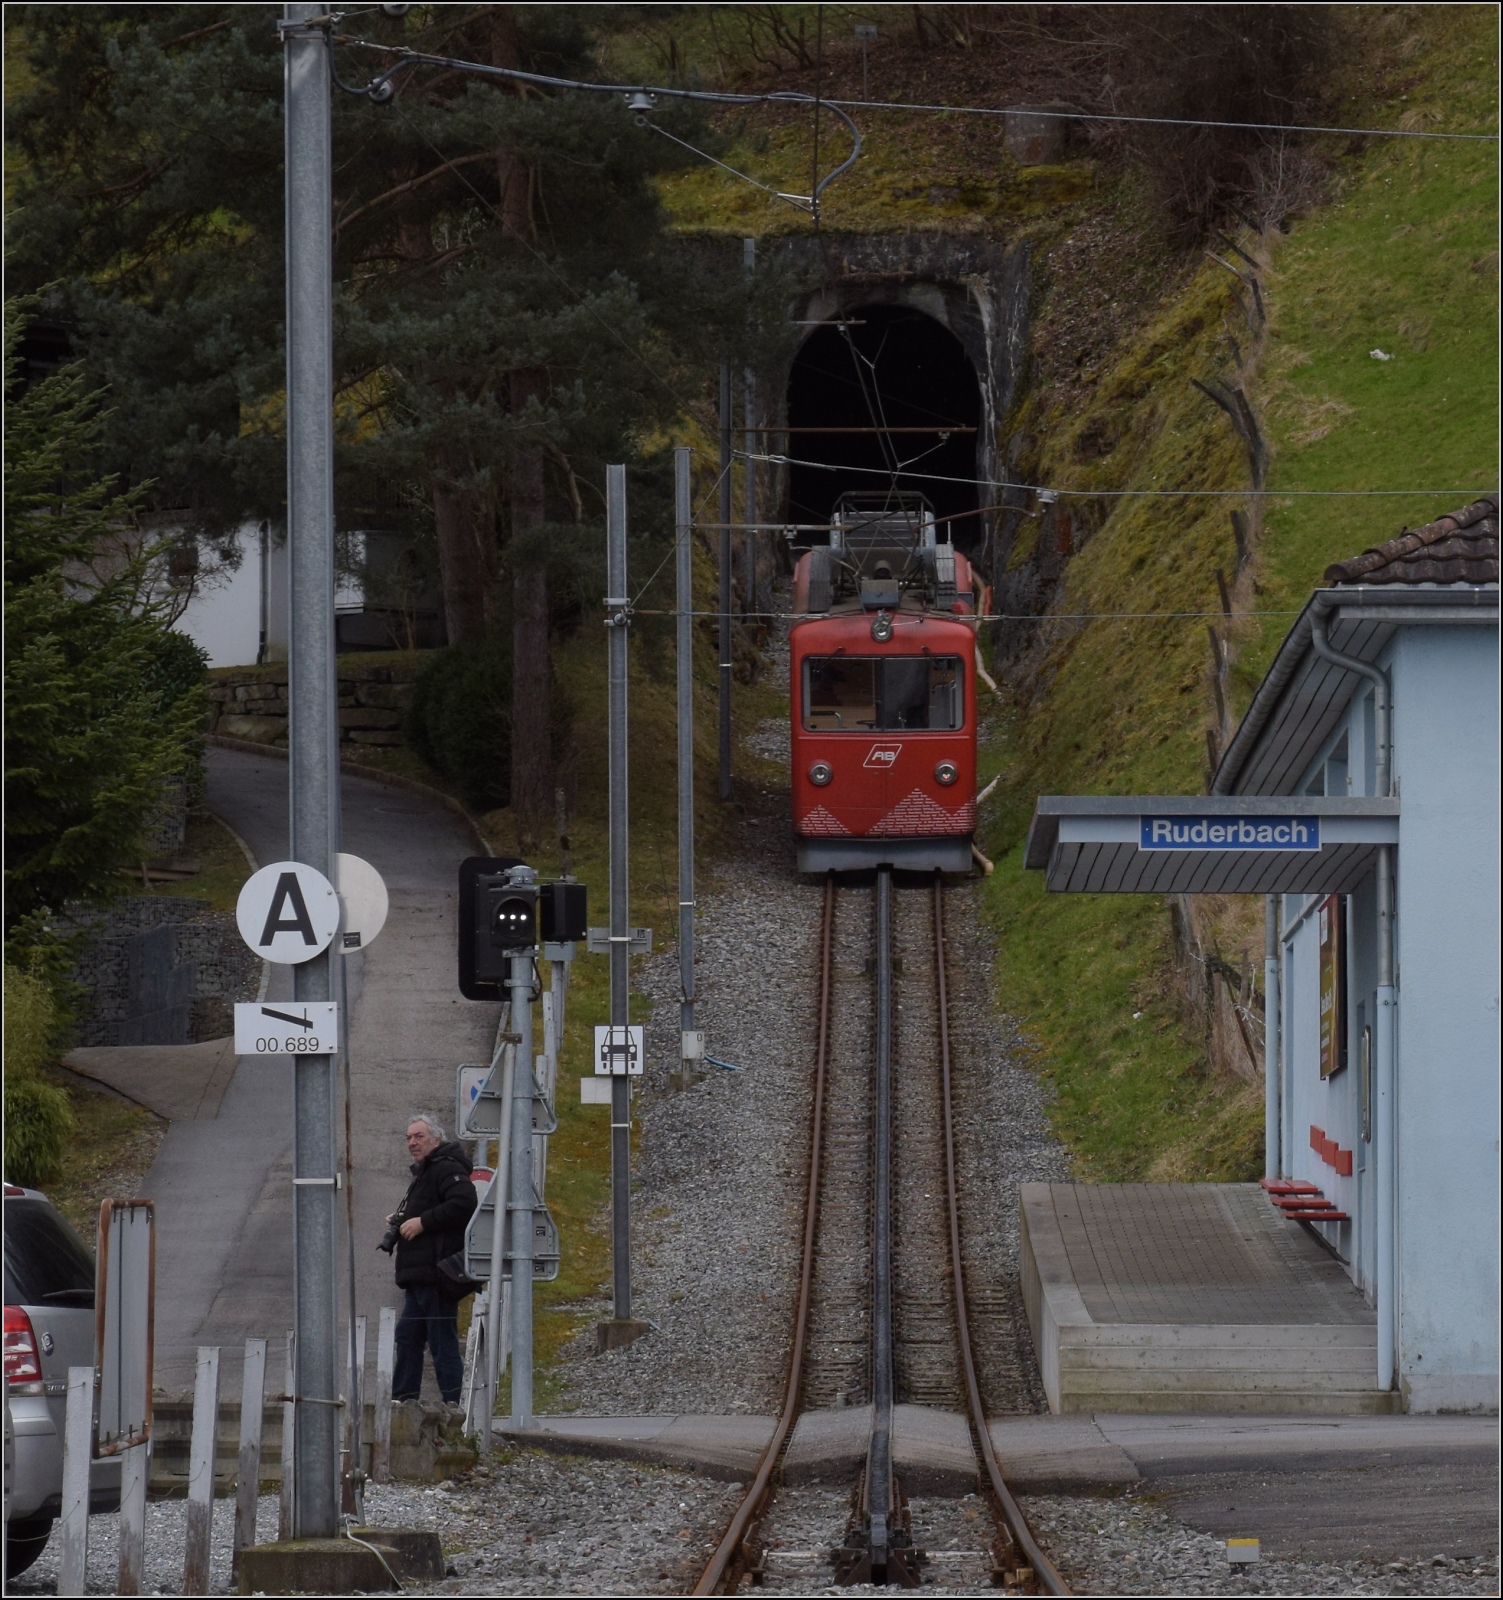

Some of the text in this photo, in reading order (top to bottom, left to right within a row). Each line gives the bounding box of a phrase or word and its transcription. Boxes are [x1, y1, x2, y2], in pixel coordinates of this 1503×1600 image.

[871, 751, 896, 761] AB
[1152, 819, 1308, 843] Ruderbach
[258, 871, 318, 947] A
[255, 1036, 319, 1053] 00.689
